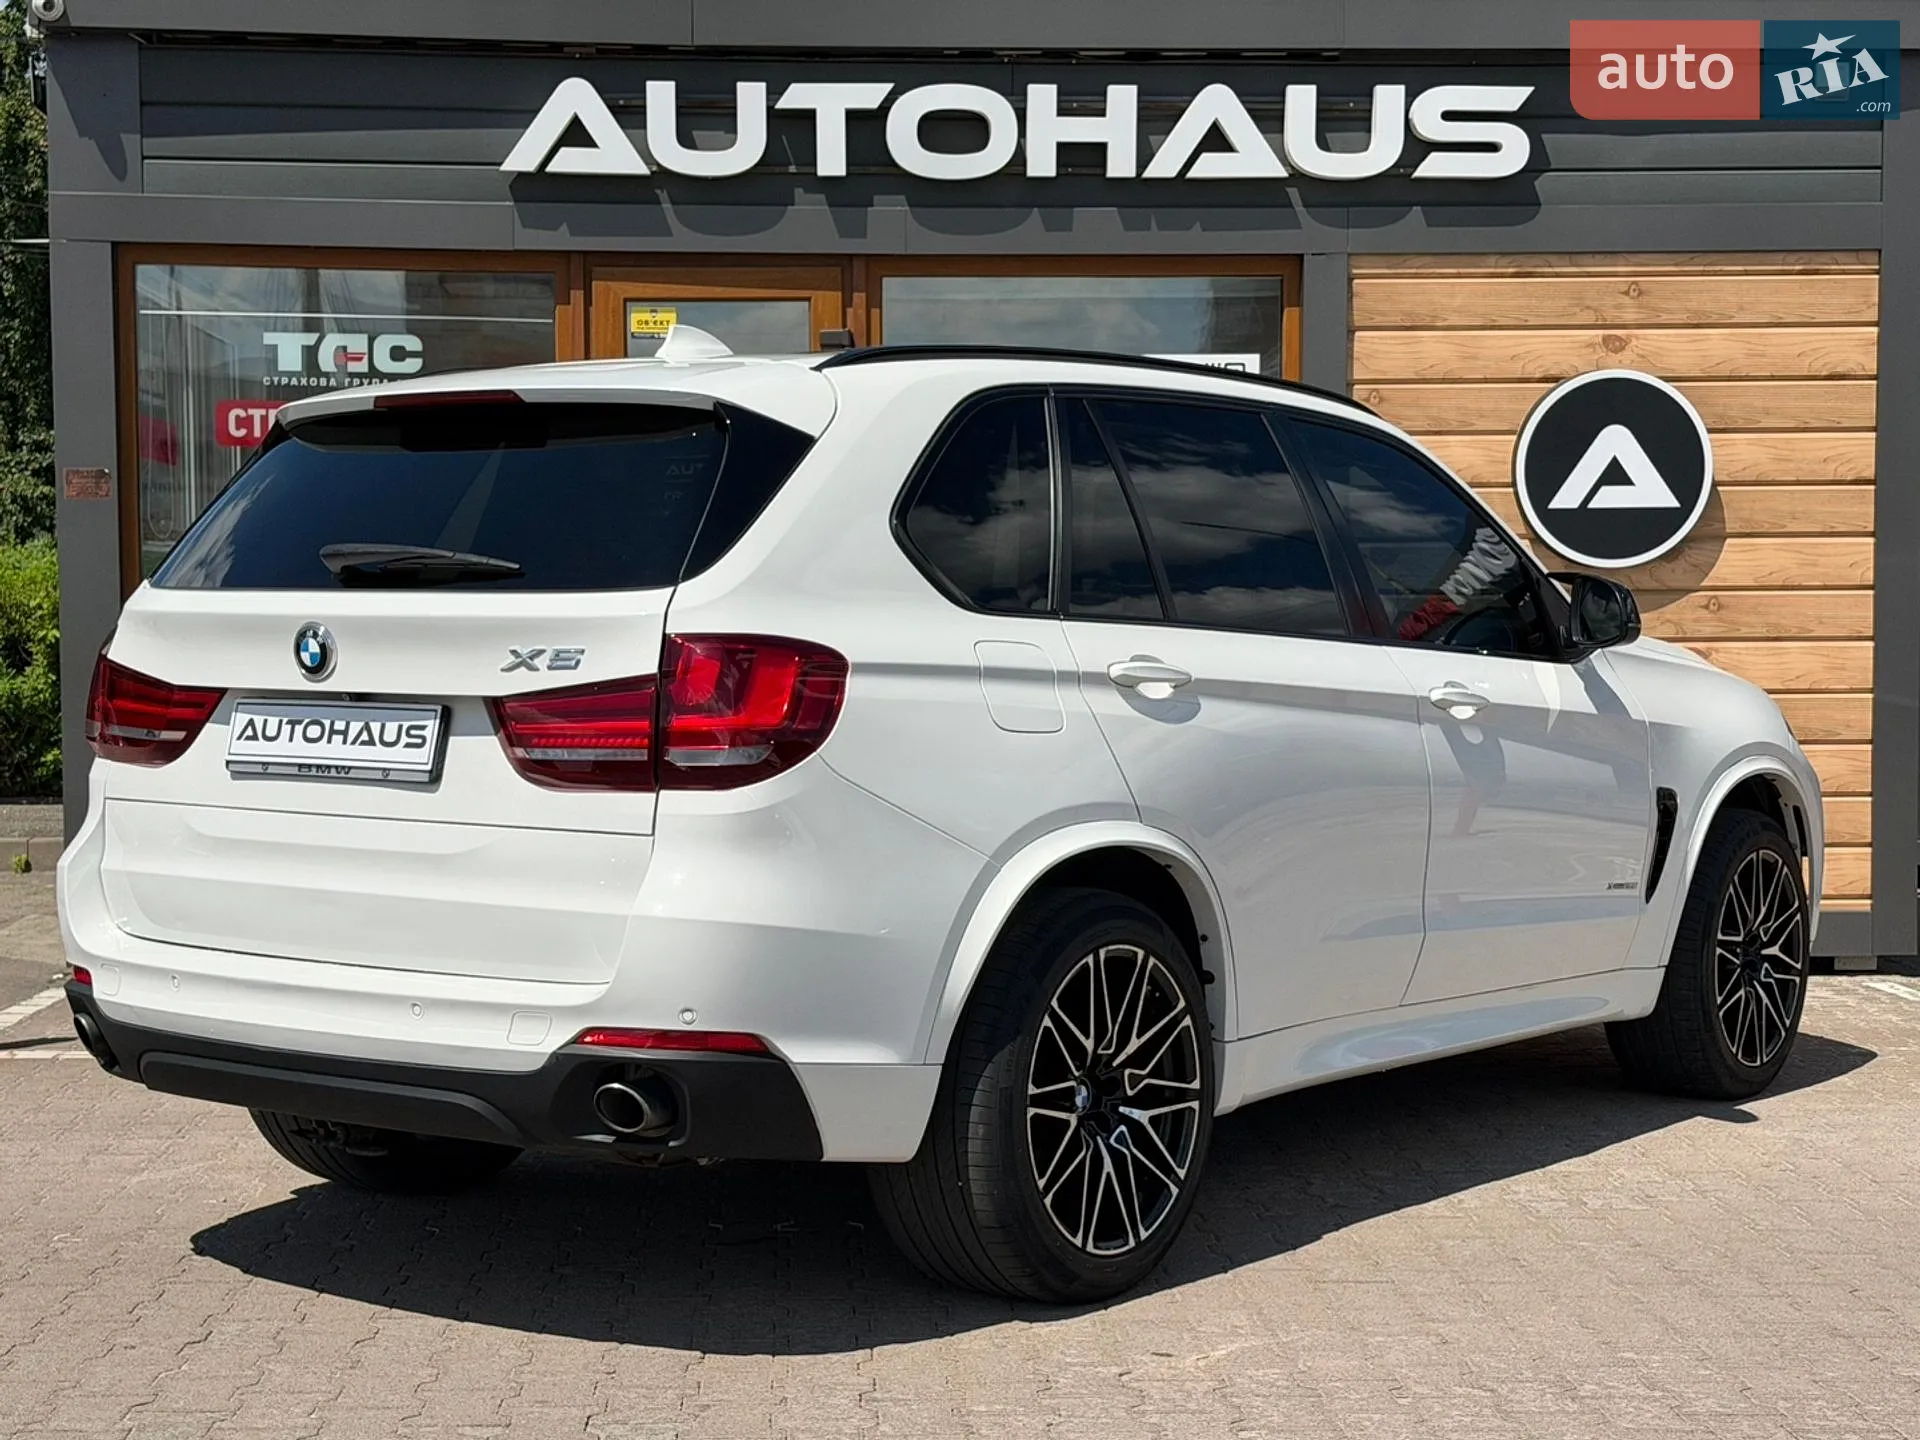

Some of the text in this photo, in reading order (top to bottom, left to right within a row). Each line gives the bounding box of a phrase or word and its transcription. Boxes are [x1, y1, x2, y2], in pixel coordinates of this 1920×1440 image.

[500, 77, 1536, 180] AUTOHAUS
[263, 376, 337, 387] СТРАХОВА
[500, 648, 586, 673] X5
[236, 717, 428, 749] AUTOHAUS
[297, 764, 352, 775] BMW
